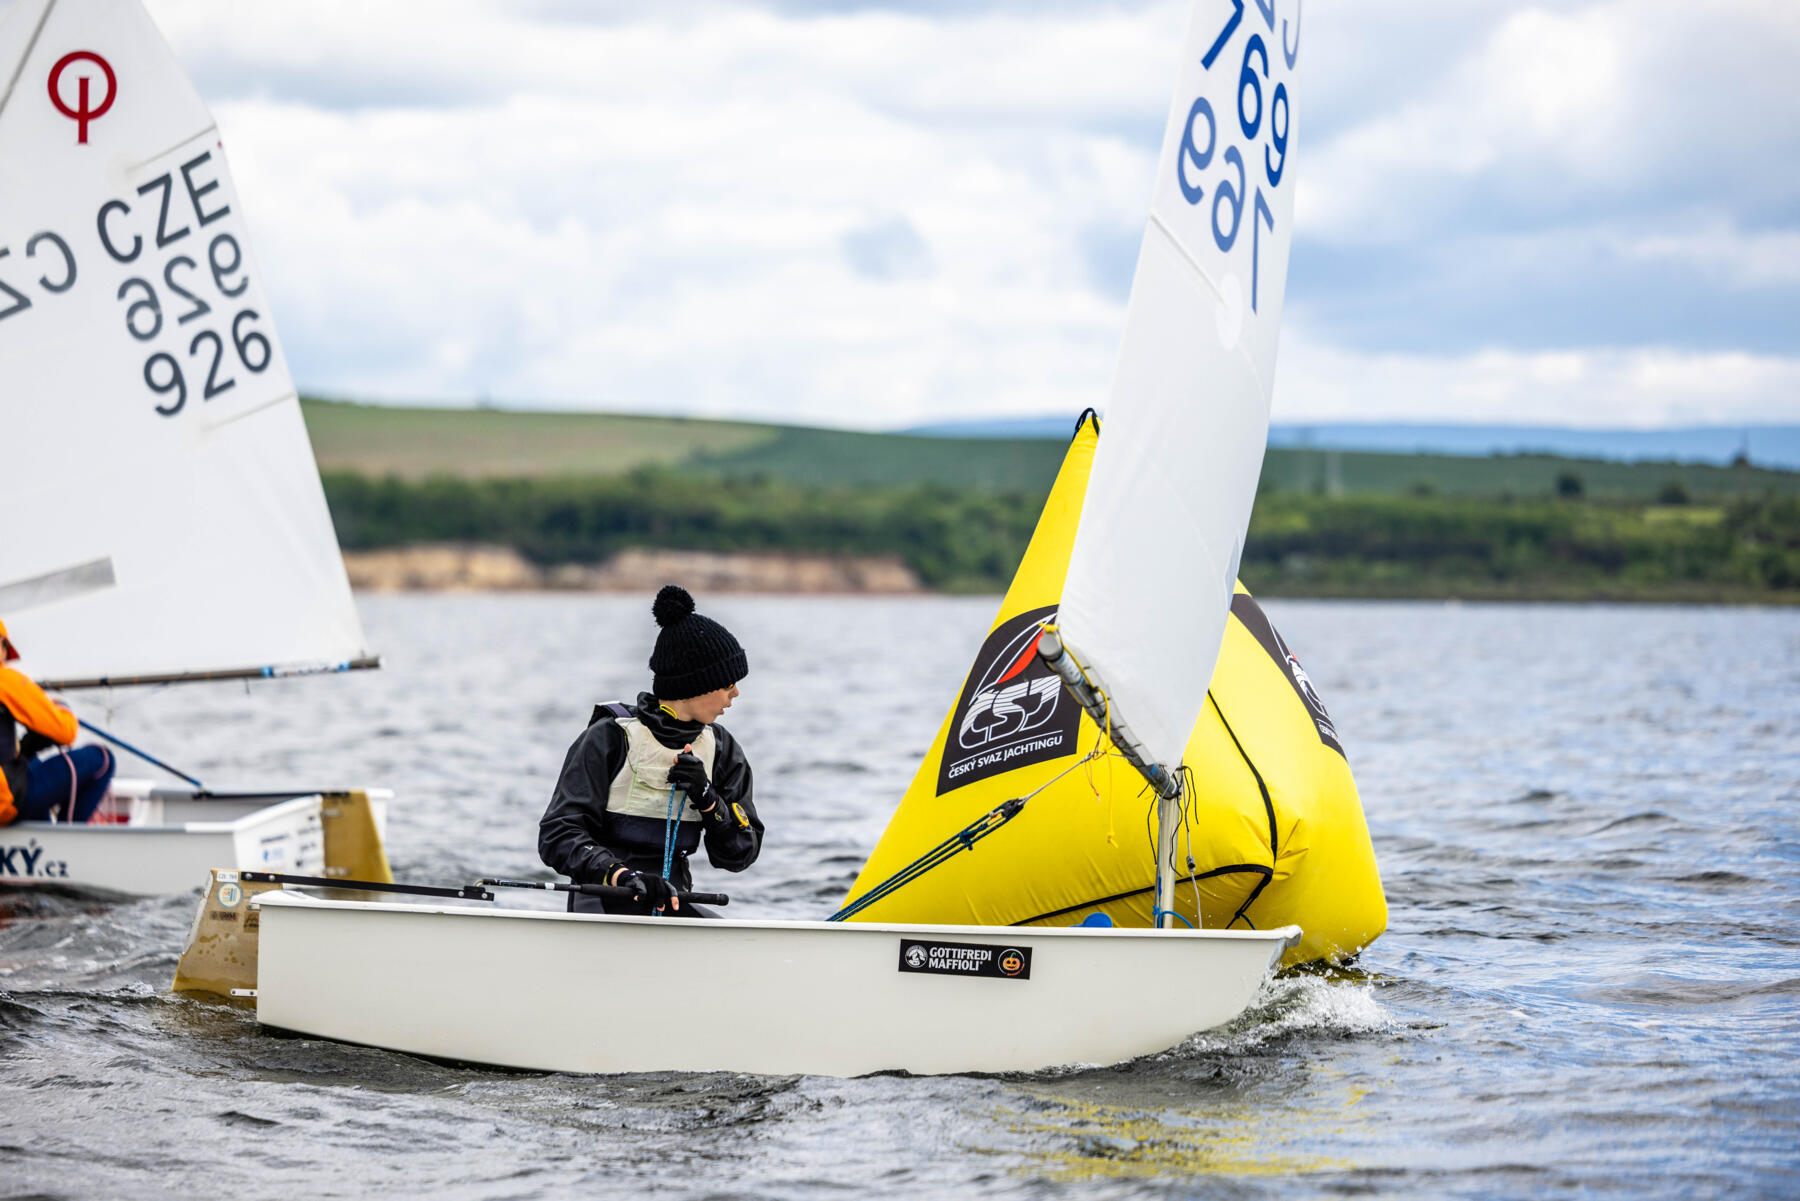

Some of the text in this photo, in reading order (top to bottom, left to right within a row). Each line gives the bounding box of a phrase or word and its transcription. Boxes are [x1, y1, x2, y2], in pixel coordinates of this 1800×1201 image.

[96, 150, 232, 264] CZE
[143, 308, 272, 417] 926
[948, 735, 1063, 779] ČESKÝ SVAZ JACHTINGU
[928, 958, 980, 971] MAFFIOLI
[929, 946, 992, 961] GOTTIFREDI
